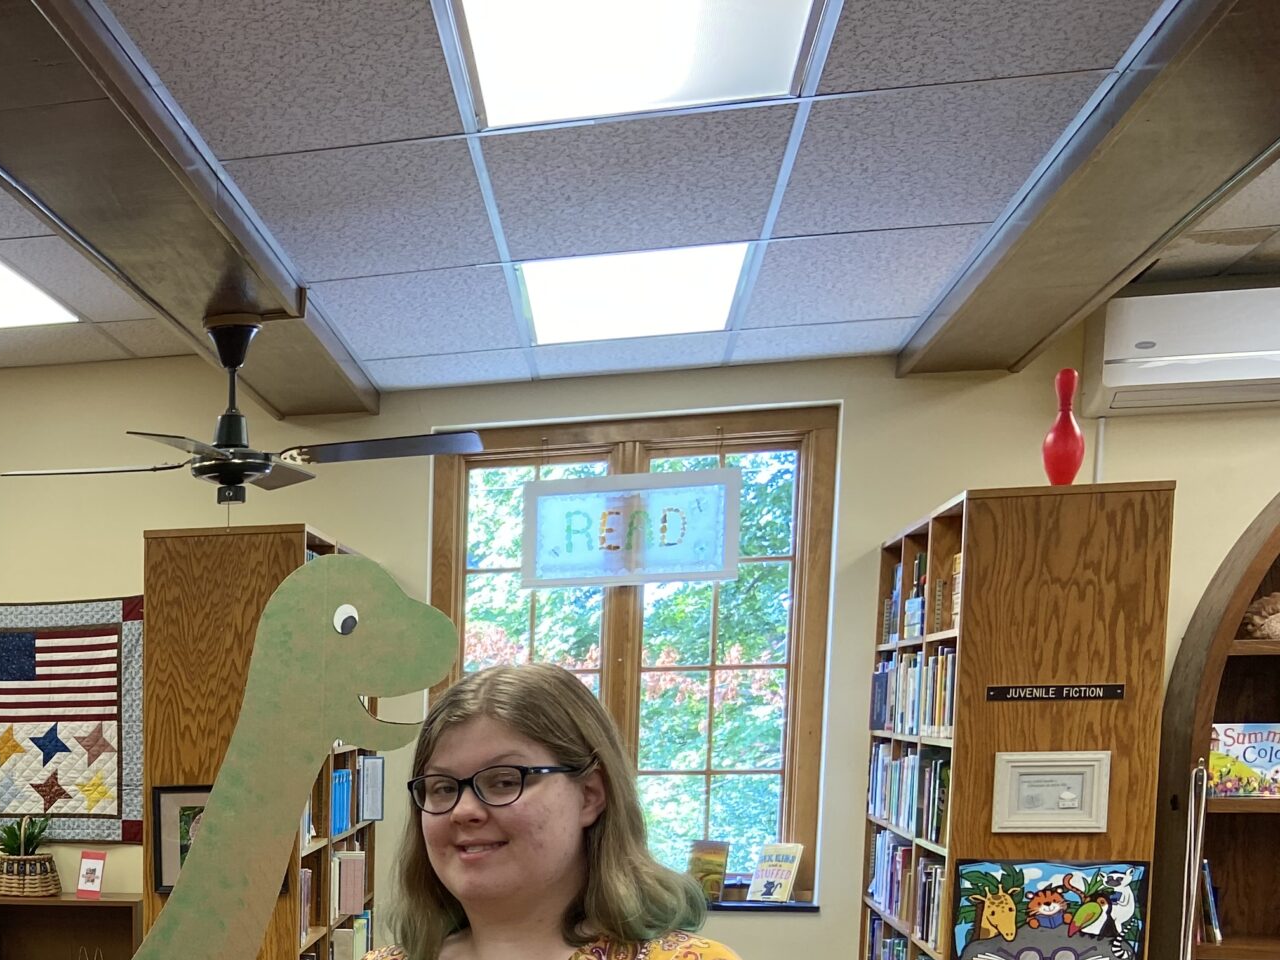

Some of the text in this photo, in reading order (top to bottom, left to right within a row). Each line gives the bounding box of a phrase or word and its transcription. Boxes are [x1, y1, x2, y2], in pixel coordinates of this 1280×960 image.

[565, 508, 688, 553] READ
[1006, 686, 1104, 699] JUVENILE FICTION
[754, 867, 793, 881] STUFFED
